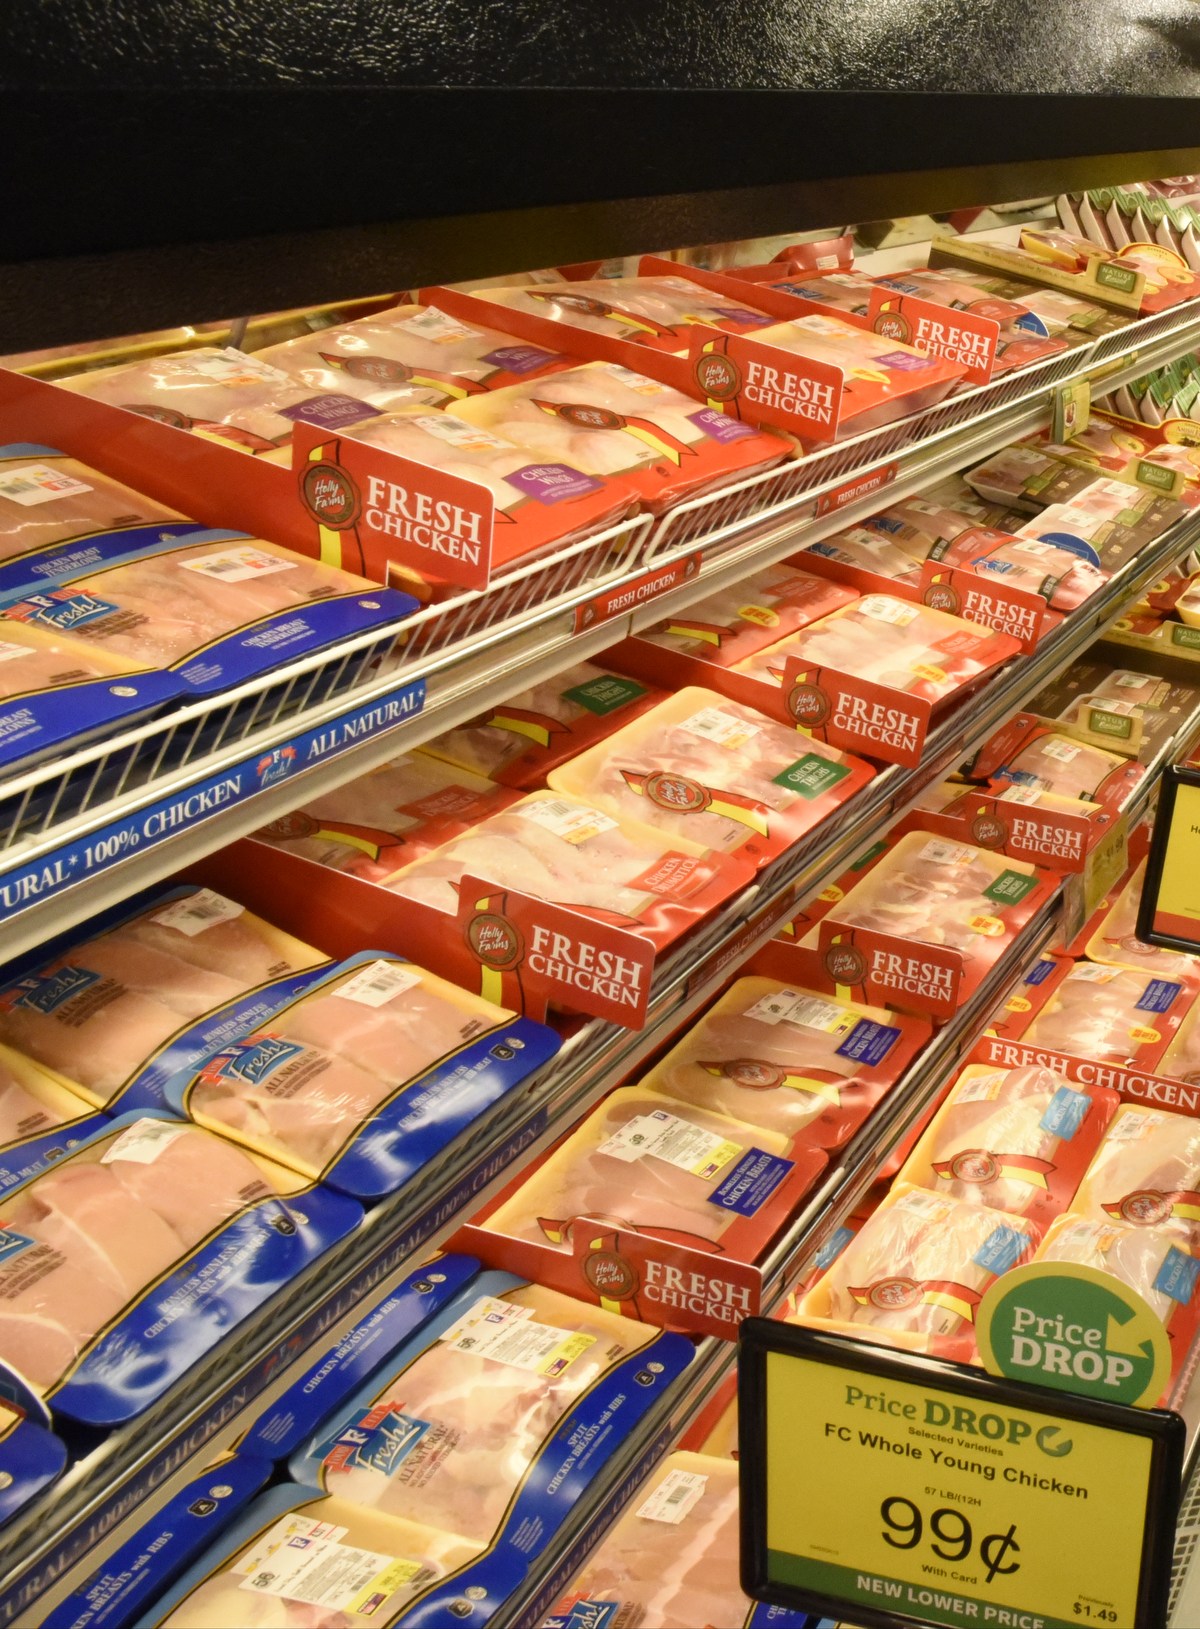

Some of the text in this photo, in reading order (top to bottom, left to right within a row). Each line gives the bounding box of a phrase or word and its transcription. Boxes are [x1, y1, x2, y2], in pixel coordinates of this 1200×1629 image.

[1102, 266, 1133, 281] NATURE
[882, 321, 899, 332] Holly
[916, 318, 992, 357] FRESH
[914, 338, 989, 371] CHICKEN
[705, 365, 726, 378] Holly
[746, 361, 835, 409] FRESH
[301, 397, 352, 414] CHICKEN
[317, 405, 360, 420] WINGS
[744, 385, 833, 425] CHICKEN
[315, 479, 339, 496] Holly
[521, 467, 565, 481] CHICKEN
[538, 474, 574, 486] WINGS
[838, 476, 881, 505] FRESH CHICKEN
[366, 475, 482, 545] FRESH
[365, 508, 481, 566] CHICKEN
[31, 554, 70, 574] CHICKEN
[43, 555, 103, 577] TENDERLOINS
[608, 571, 676, 614] FRESH CHICKEN
[37, 593, 103, 629] Fresh!
[962, 609, 1034, 641] CHICKEN
[965, 590, 1037, 629] FRESH
[254, 624, 310, 648] TENDERLOINS
[796, 694, 817, 706] Holly
[836, 692, 920, 739] FRESH
[307, 733, 341, 760] ALL
[833, 713, 918, 753] CHICKEN
[787, 761, 821, 783] CHICKEN
[799, 767, 831, 788] THIGHS
[83, 775, 243, 871] 100% CHICKEN
[1012, 818, 1082, 849] FRESH
[1010, 835, 1081, 861] CHICKEN
[644, 857, 682, 886] CHICKEN
[479, 925, 504, 942] Holly
[530, 924, 643, 990] FRESH
[872, 950, 954, 989] FRESH
[528, 953, 641, 1009] CHICKEN
[870, 970, 952, 1002] CHICKEN
[201, 1018, 235, 1042] BONELESS
[229, 1038, 292, 1085] Fresh!
[989, 1041, 1199, 1110] FRESH CHICKEN
[17, 1161, 43, 1180] MEAT
[718, 1169, 740, 1197] BONELESS
[723, 1154, 773, 1206] CHICKEN BREASTS
[158, 1245, 239, 1314] BONELESS SKINLESS
[595, 1262, 618, 1277] Holly
[645, 1260, 752, 1311] FRESH
[643, 1284, 751, 1325] CHICKEN
[144, 1302, 184, 1339] CHICKEN
[1012, 1306, 1102, 1348] Price
[303, 1298, 400, 1393] CHICKEN BREASTS RIBS
[456, 1335, 478, 1351] 56
[1010, 1334, 1134, 1386] DROP
[362, 1407, 389, 1429] CITY
[845, 1385, 1032, 1446] Price DROP
[352, 1409, 422, 1477] Fresh!
[547, 1393, 627, 1496] CHICKEN BREASTS RIBS
[568, 1423, 589, 1447] SPLIT
[908, 1426, 1004, 1457] Selected Varieties
[398, 1463, 414, 1486] ALL
[824, 1423, 1089, 1499] FC Whole Young Chicken
[924, 1486, 982, 1507] 57 LB/(12H
[880, 1495, 1021, 1584] 99¢
[87, 1572, 116, 1602] SPLIT
[91, 1531, 174, 1612] BREASTS RIBS
[251, 1570, 276, 1590] 56
[921, 1563, 978, 1585] With Card
[857, 1574, 1045, 1629] NEW LOWER PRICE
[1073, 1600, 1118, 1623] $1.49
